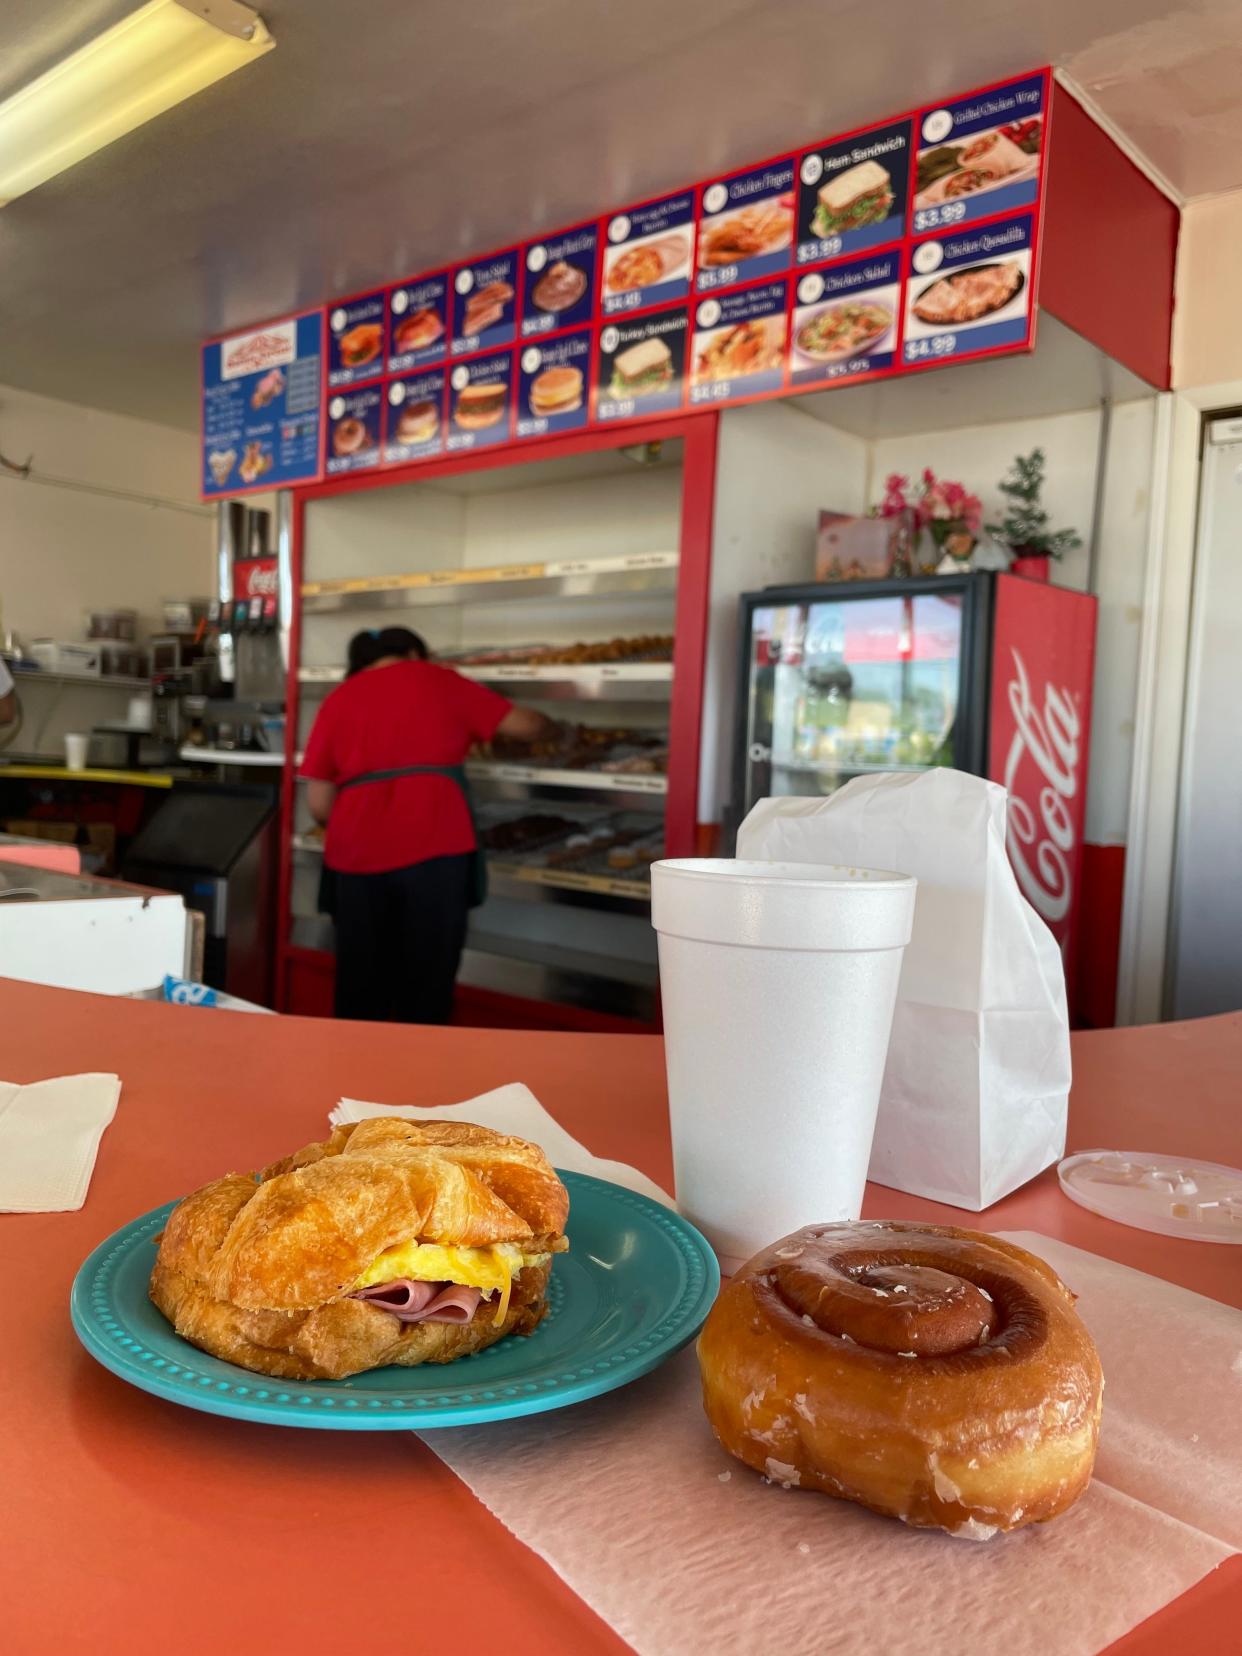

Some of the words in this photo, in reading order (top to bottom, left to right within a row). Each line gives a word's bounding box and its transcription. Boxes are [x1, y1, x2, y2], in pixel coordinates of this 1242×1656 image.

[980, 97, 1015, 117] Chicken
[1016, 89, 1040, 105] Wrap
[824, 154, 851, 175] Ham
[851, 135, 906, 162] Sandwich
[729, 179, 764, 200] Chicken
[914, 201, 966, 231] $3.99
[797, 237, 842, 263] $3.99
[944, 240, 980, 259] Chicken
[825, 271, 864, 292] Chicken
[863, 263, 891, 281] Salad
[904, 333, 957, 360] $4.99
[1004, 646, 1080, 922] Cola
